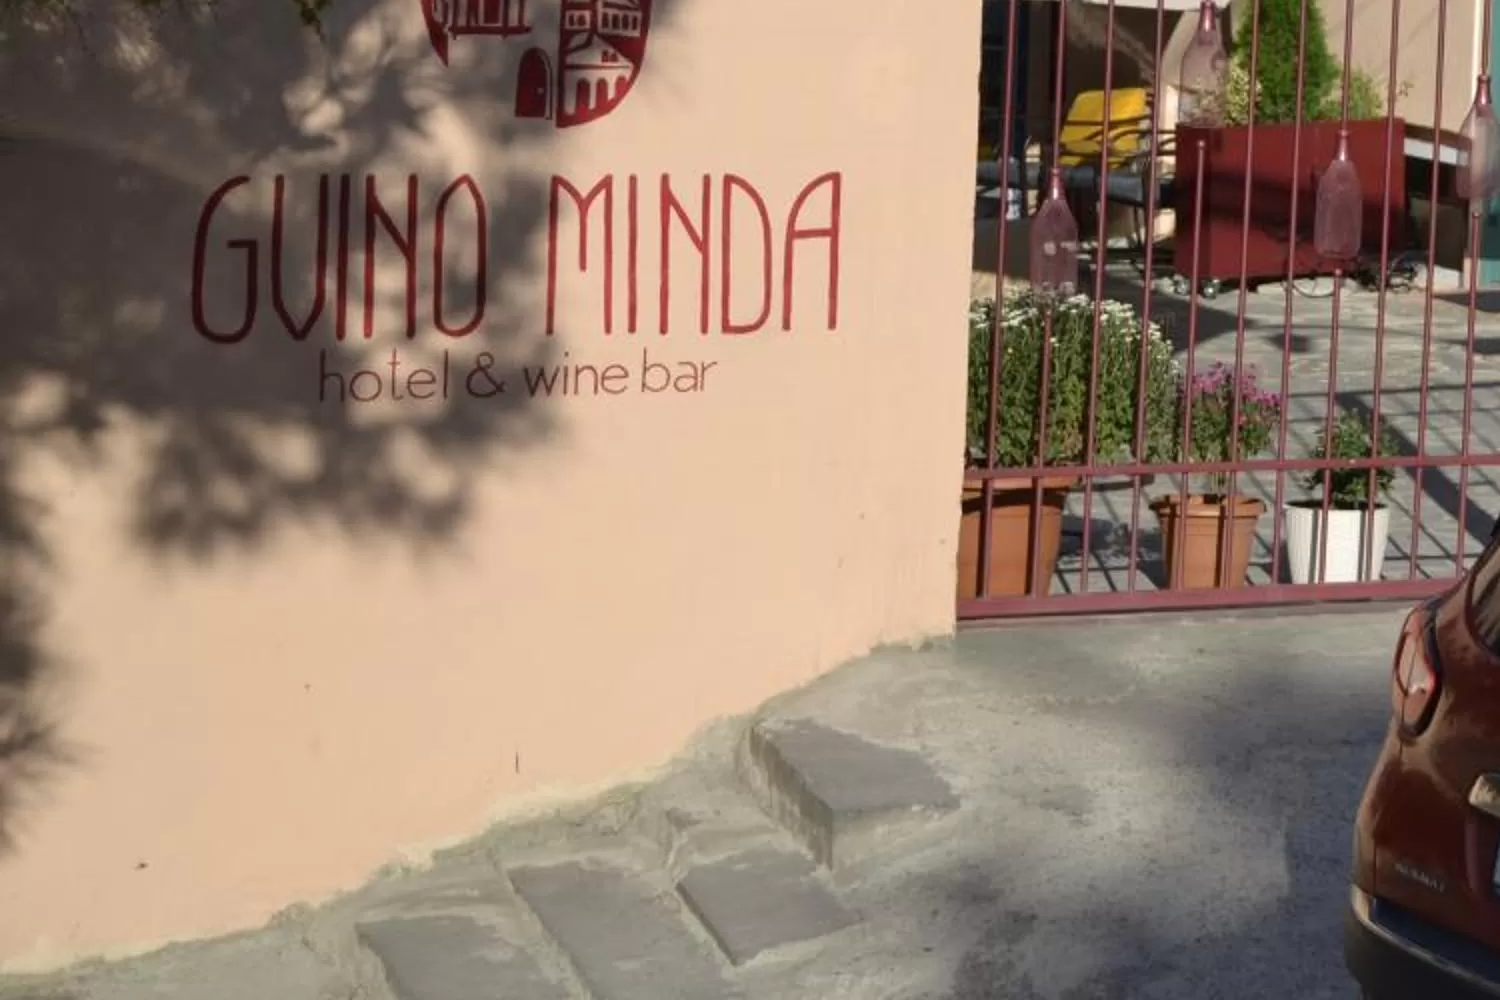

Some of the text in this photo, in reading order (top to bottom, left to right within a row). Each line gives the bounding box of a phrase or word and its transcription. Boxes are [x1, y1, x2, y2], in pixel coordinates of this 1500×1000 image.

[545, 171, 842, 338] MINDA
[319, 347, 719, 404] hotel & wine bar
